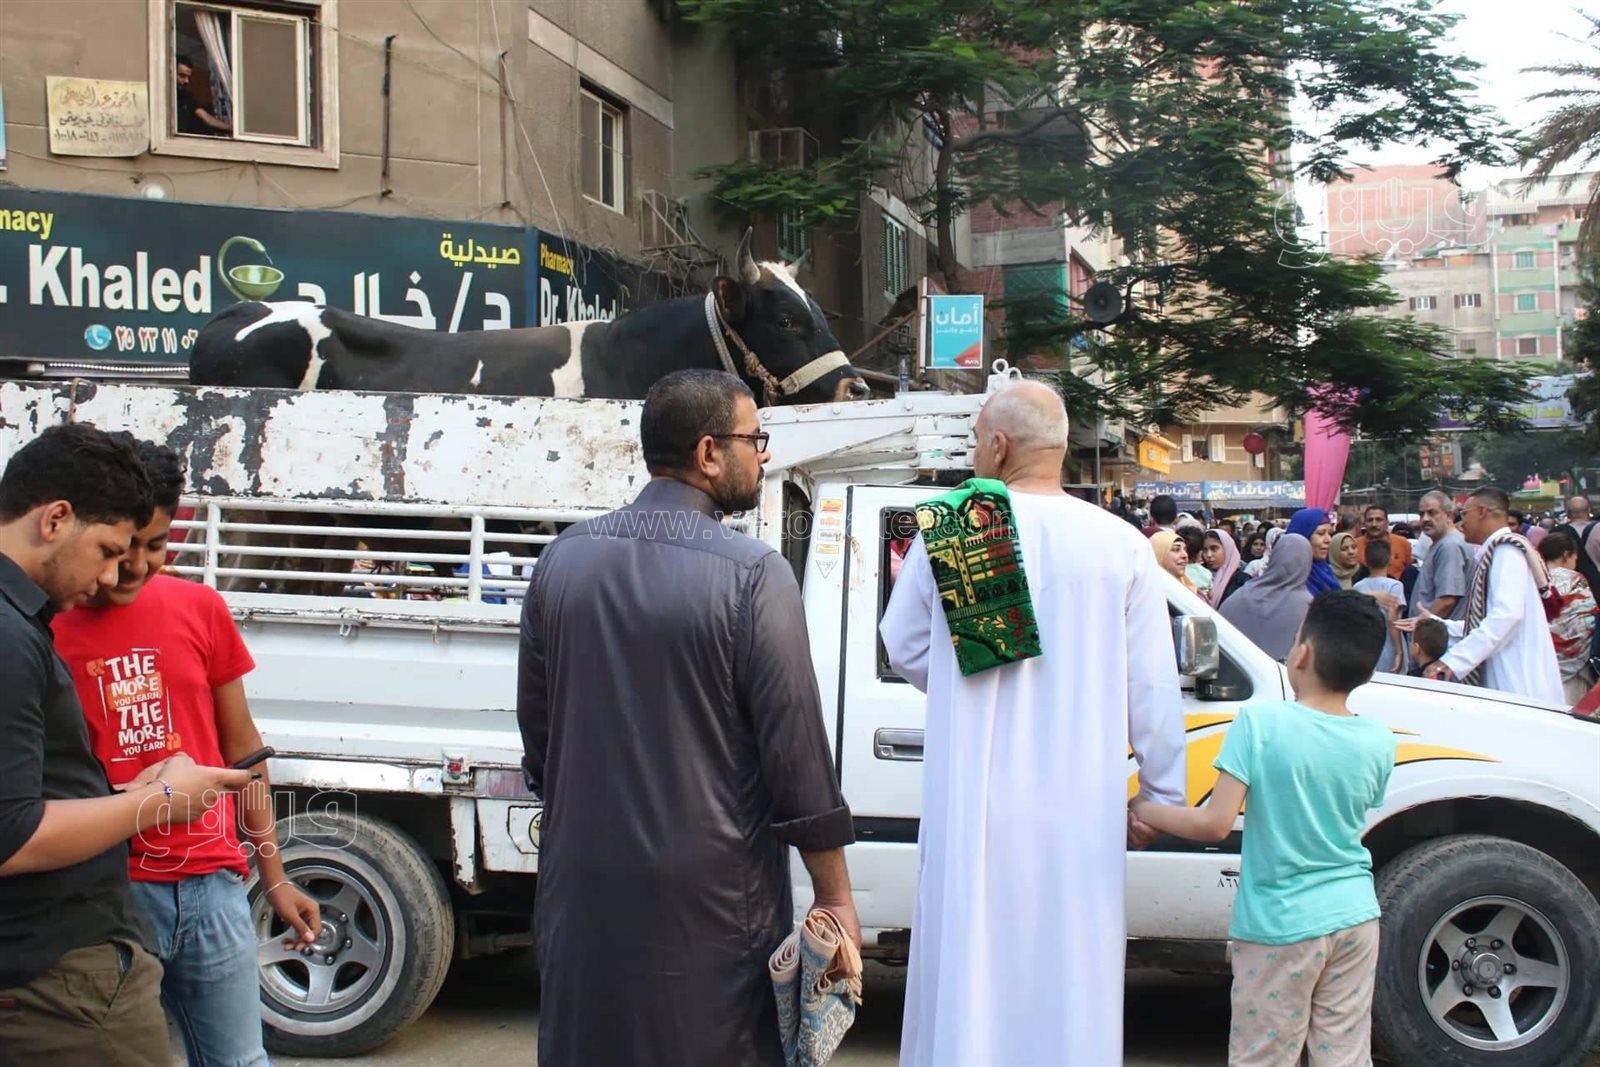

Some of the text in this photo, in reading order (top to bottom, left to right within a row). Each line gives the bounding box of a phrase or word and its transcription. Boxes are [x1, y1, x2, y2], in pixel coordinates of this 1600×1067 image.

[439, 232, 521, 269] صيدلية
[540, 242, 575, 282] Pharmacy
[28, 244, 212, 314] Khaled
[540, 277, 562, 328] Dr.
[935, 303, 980, 326] أمان
[1232, 482, 1282, 496] الباشا
[105, 653, 156, 682] THE
[111, 675, 160, 697] MORE
[114, 698, 131, 708] YOU
[116, 701, 164, 730] THE
[118, 724, 166, 747] MORE
[123, 740, 166, 757] YOU EARN
